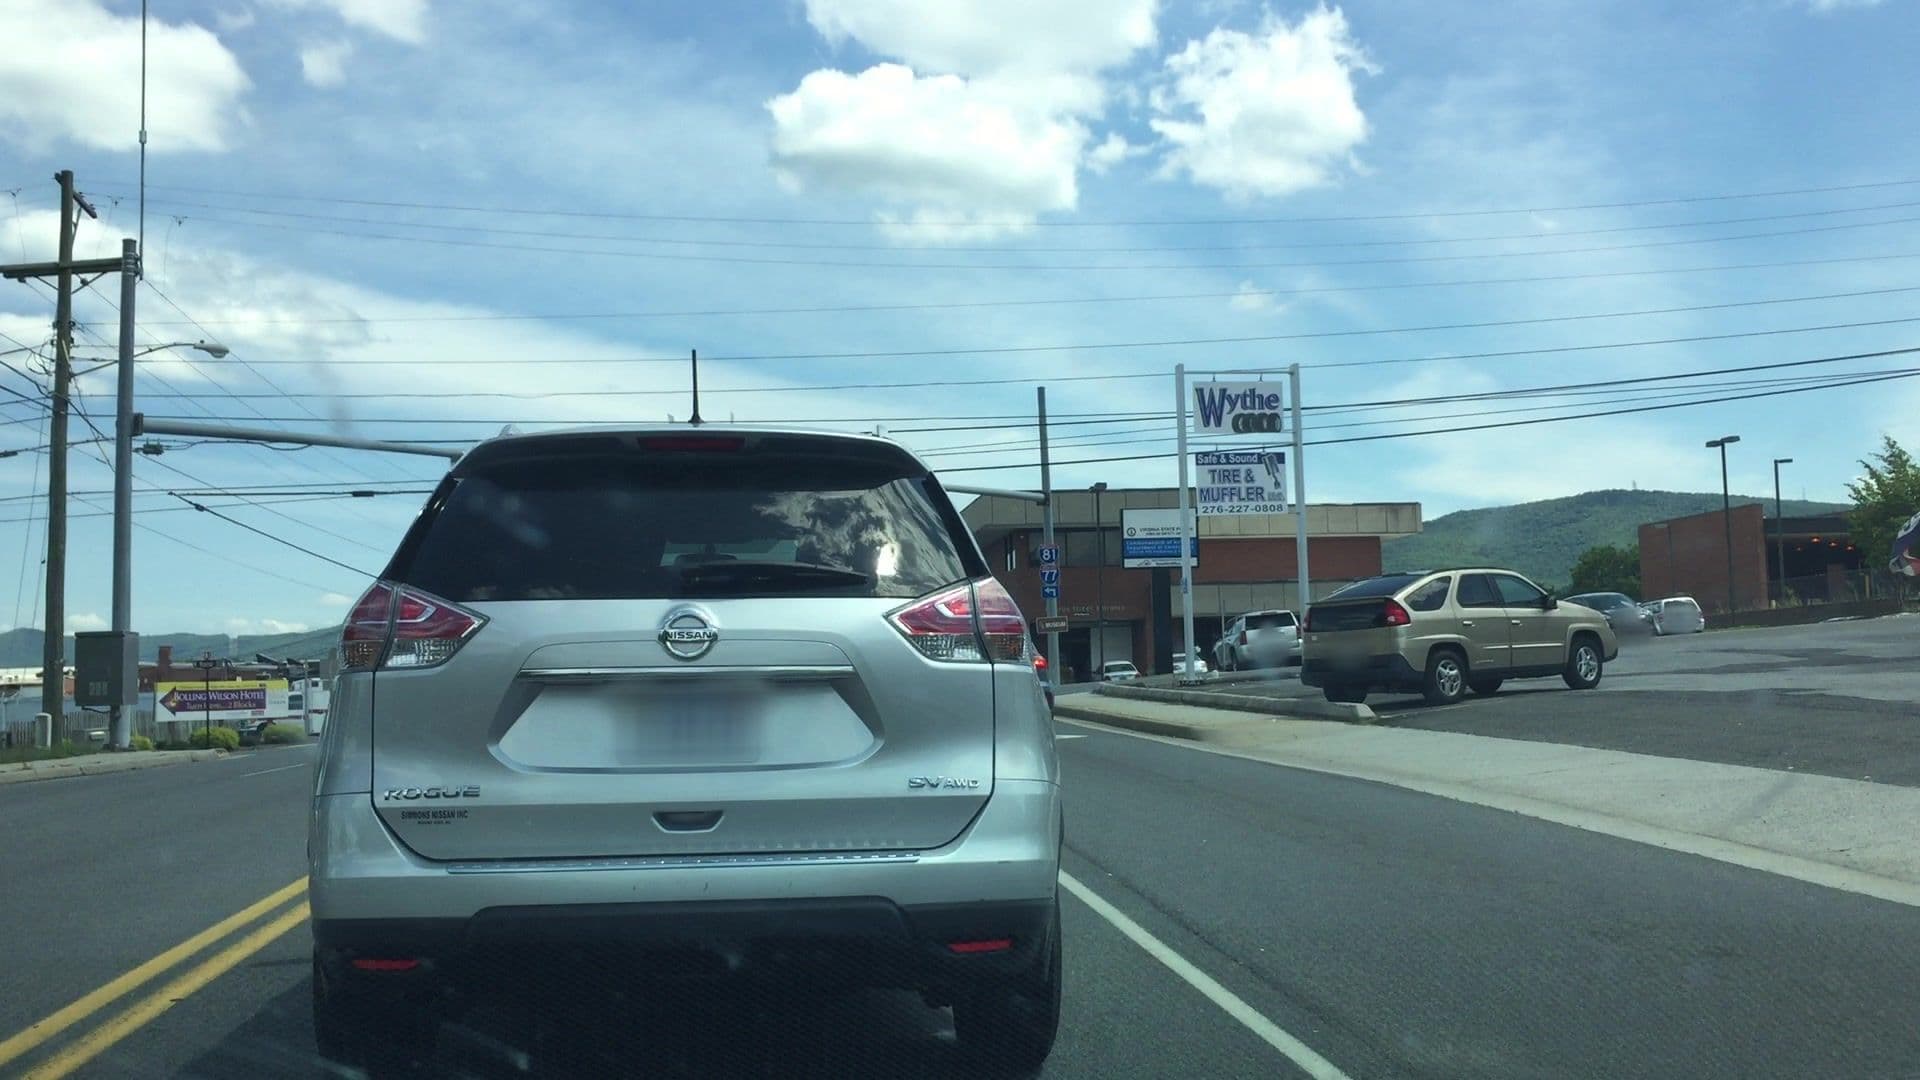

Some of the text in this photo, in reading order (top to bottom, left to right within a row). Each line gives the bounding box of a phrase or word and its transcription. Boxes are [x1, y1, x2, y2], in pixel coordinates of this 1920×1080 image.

[1195, 387, 1280, 428] Wythe
[1197, 453, 1258, 464] Safe & Sound
[1208, 468, 1255, 484] TIRE &
[1200, 487, 1266, 503] MUFFLER
[1202, 504, 1284, 513] 276-227-0808
[1042, 549, 1056, 560] 81
[1042, 569, 1057, 581] 77
[664, 631, 712, 639] NISSAN
[175, 690, 264, 701] BOLLING WILSON HOTEL
[908, 775, 980, 788] SV AWD
[384, 785, 480, 800] ROGUE
[431, 810, 456, 819] NISSAN
[457, 809, 468, 818] INC
